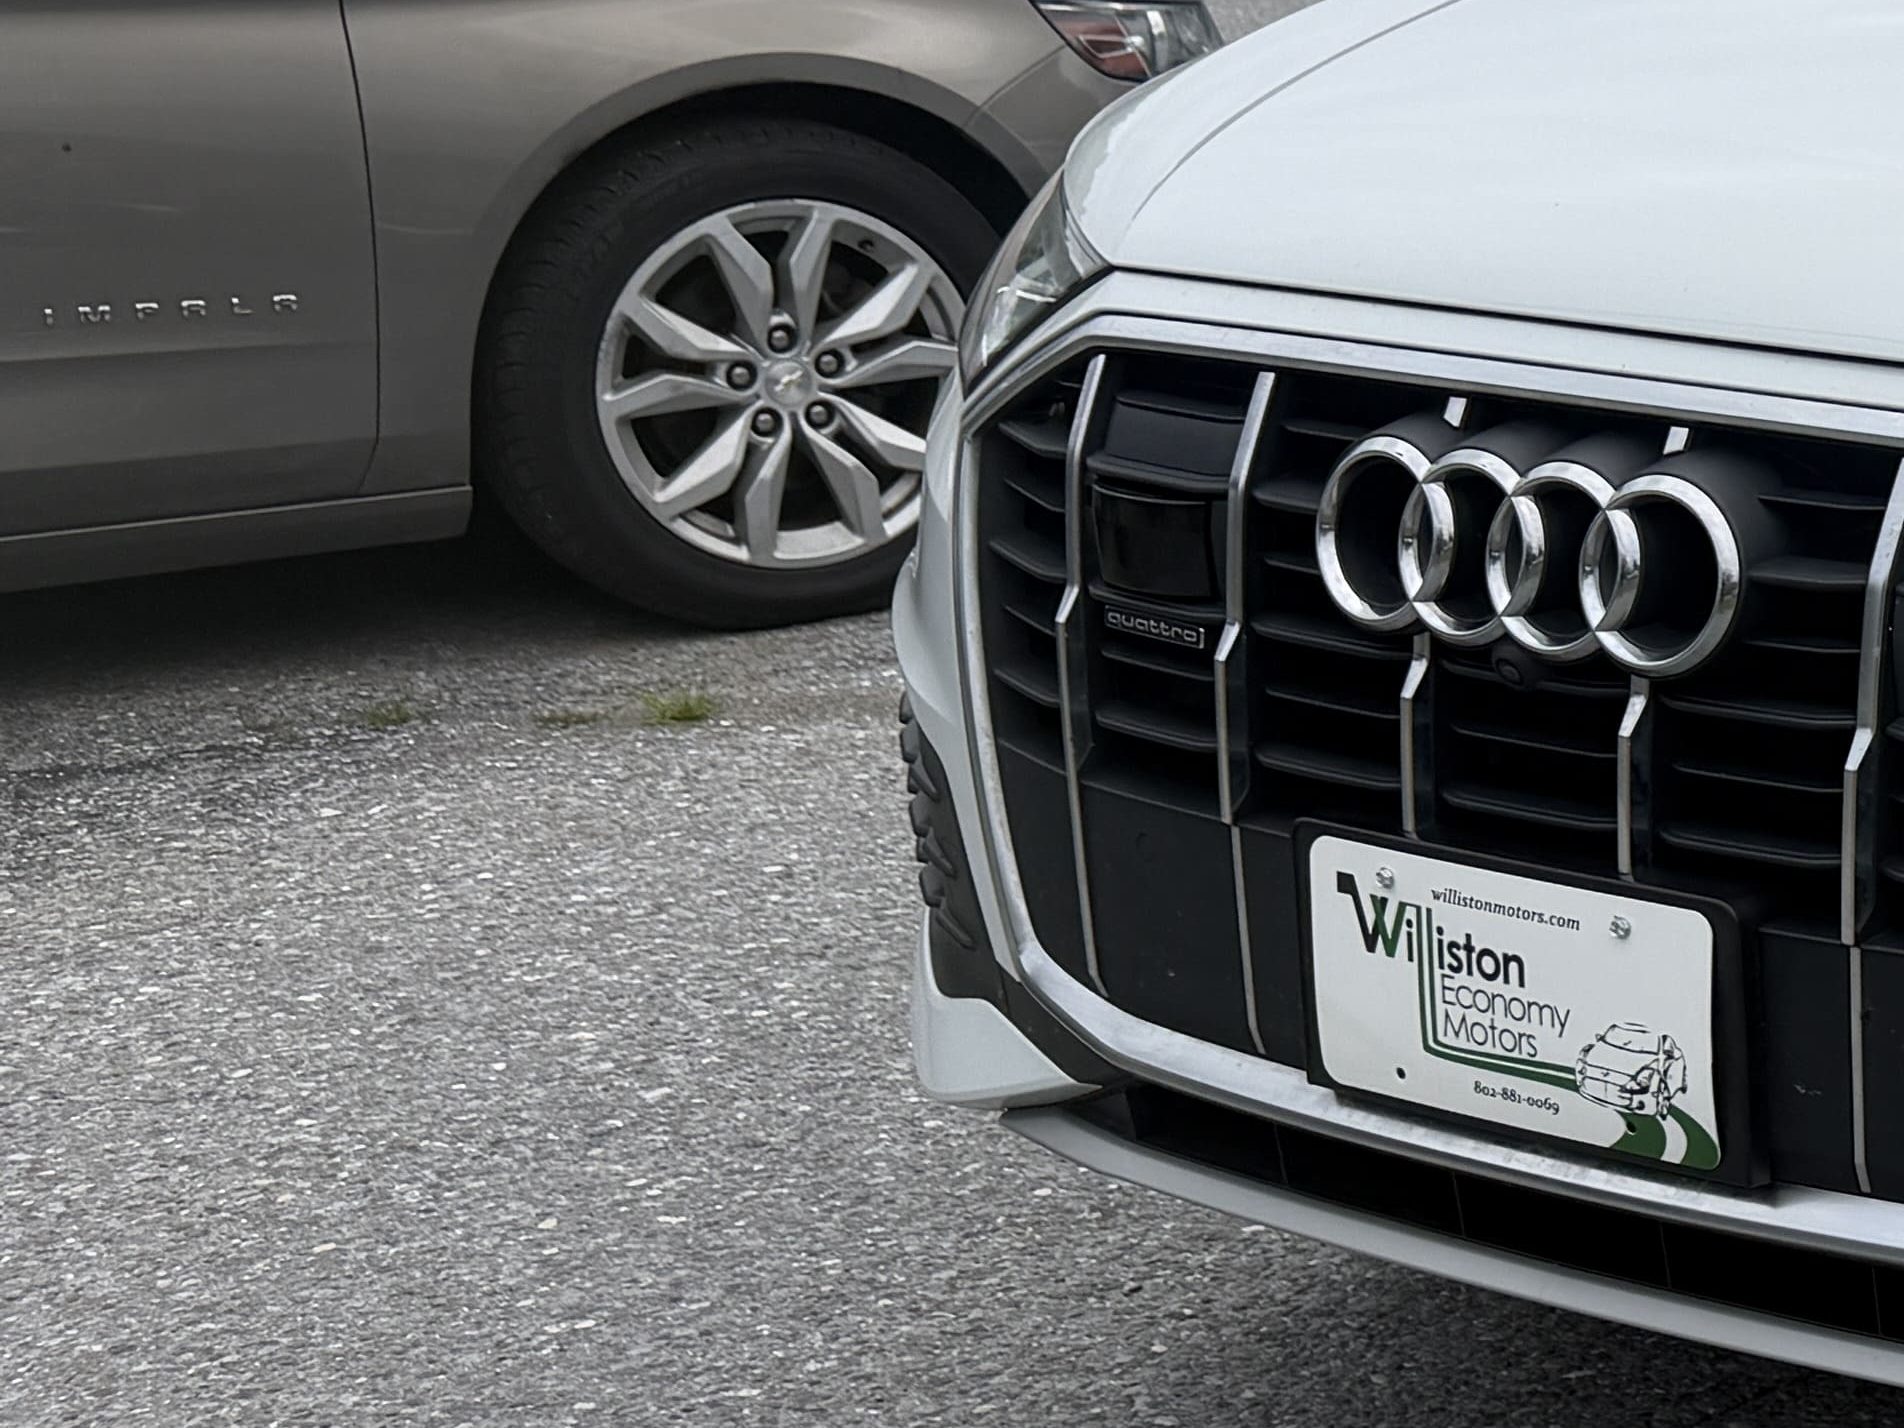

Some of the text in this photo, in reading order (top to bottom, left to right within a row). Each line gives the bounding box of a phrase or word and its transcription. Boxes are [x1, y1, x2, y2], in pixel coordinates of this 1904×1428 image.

[44, 294, 297, 326] IMPALA
[1108, 612, 1198, 642] quattro
[1336, 870, 1526, 989] Williston
[1430, 887, 1581, 932] willistonmotors.com
[1440, 973, 1571, 1038] Economy
[1443, 1008, 1538, 1058] Motors
[1473, 1080, 1560, 1116] 802-881-0069
